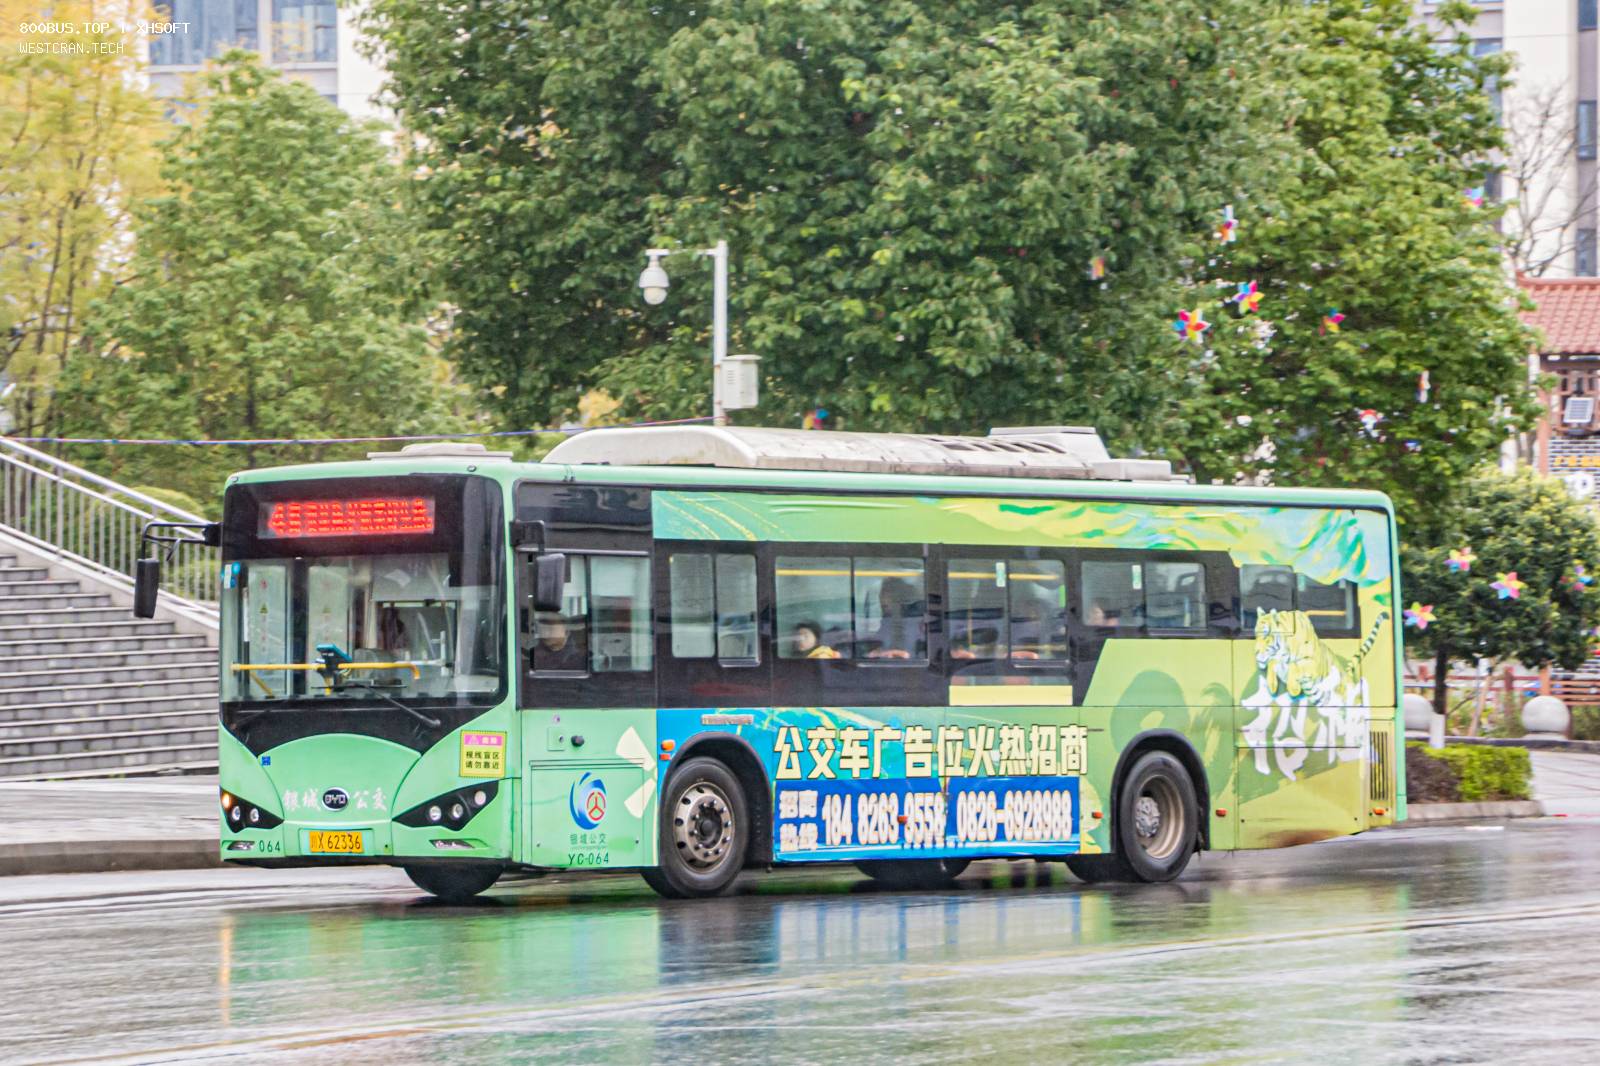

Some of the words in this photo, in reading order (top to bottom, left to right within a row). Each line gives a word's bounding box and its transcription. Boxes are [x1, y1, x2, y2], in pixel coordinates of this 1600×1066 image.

[774, 724, 1088, 779] 公交车广告位火热招商
[324, 794, 346, 804] BYD
[259, 840, 281, 852] 064
[568, 852, 609, 867] YC-064
